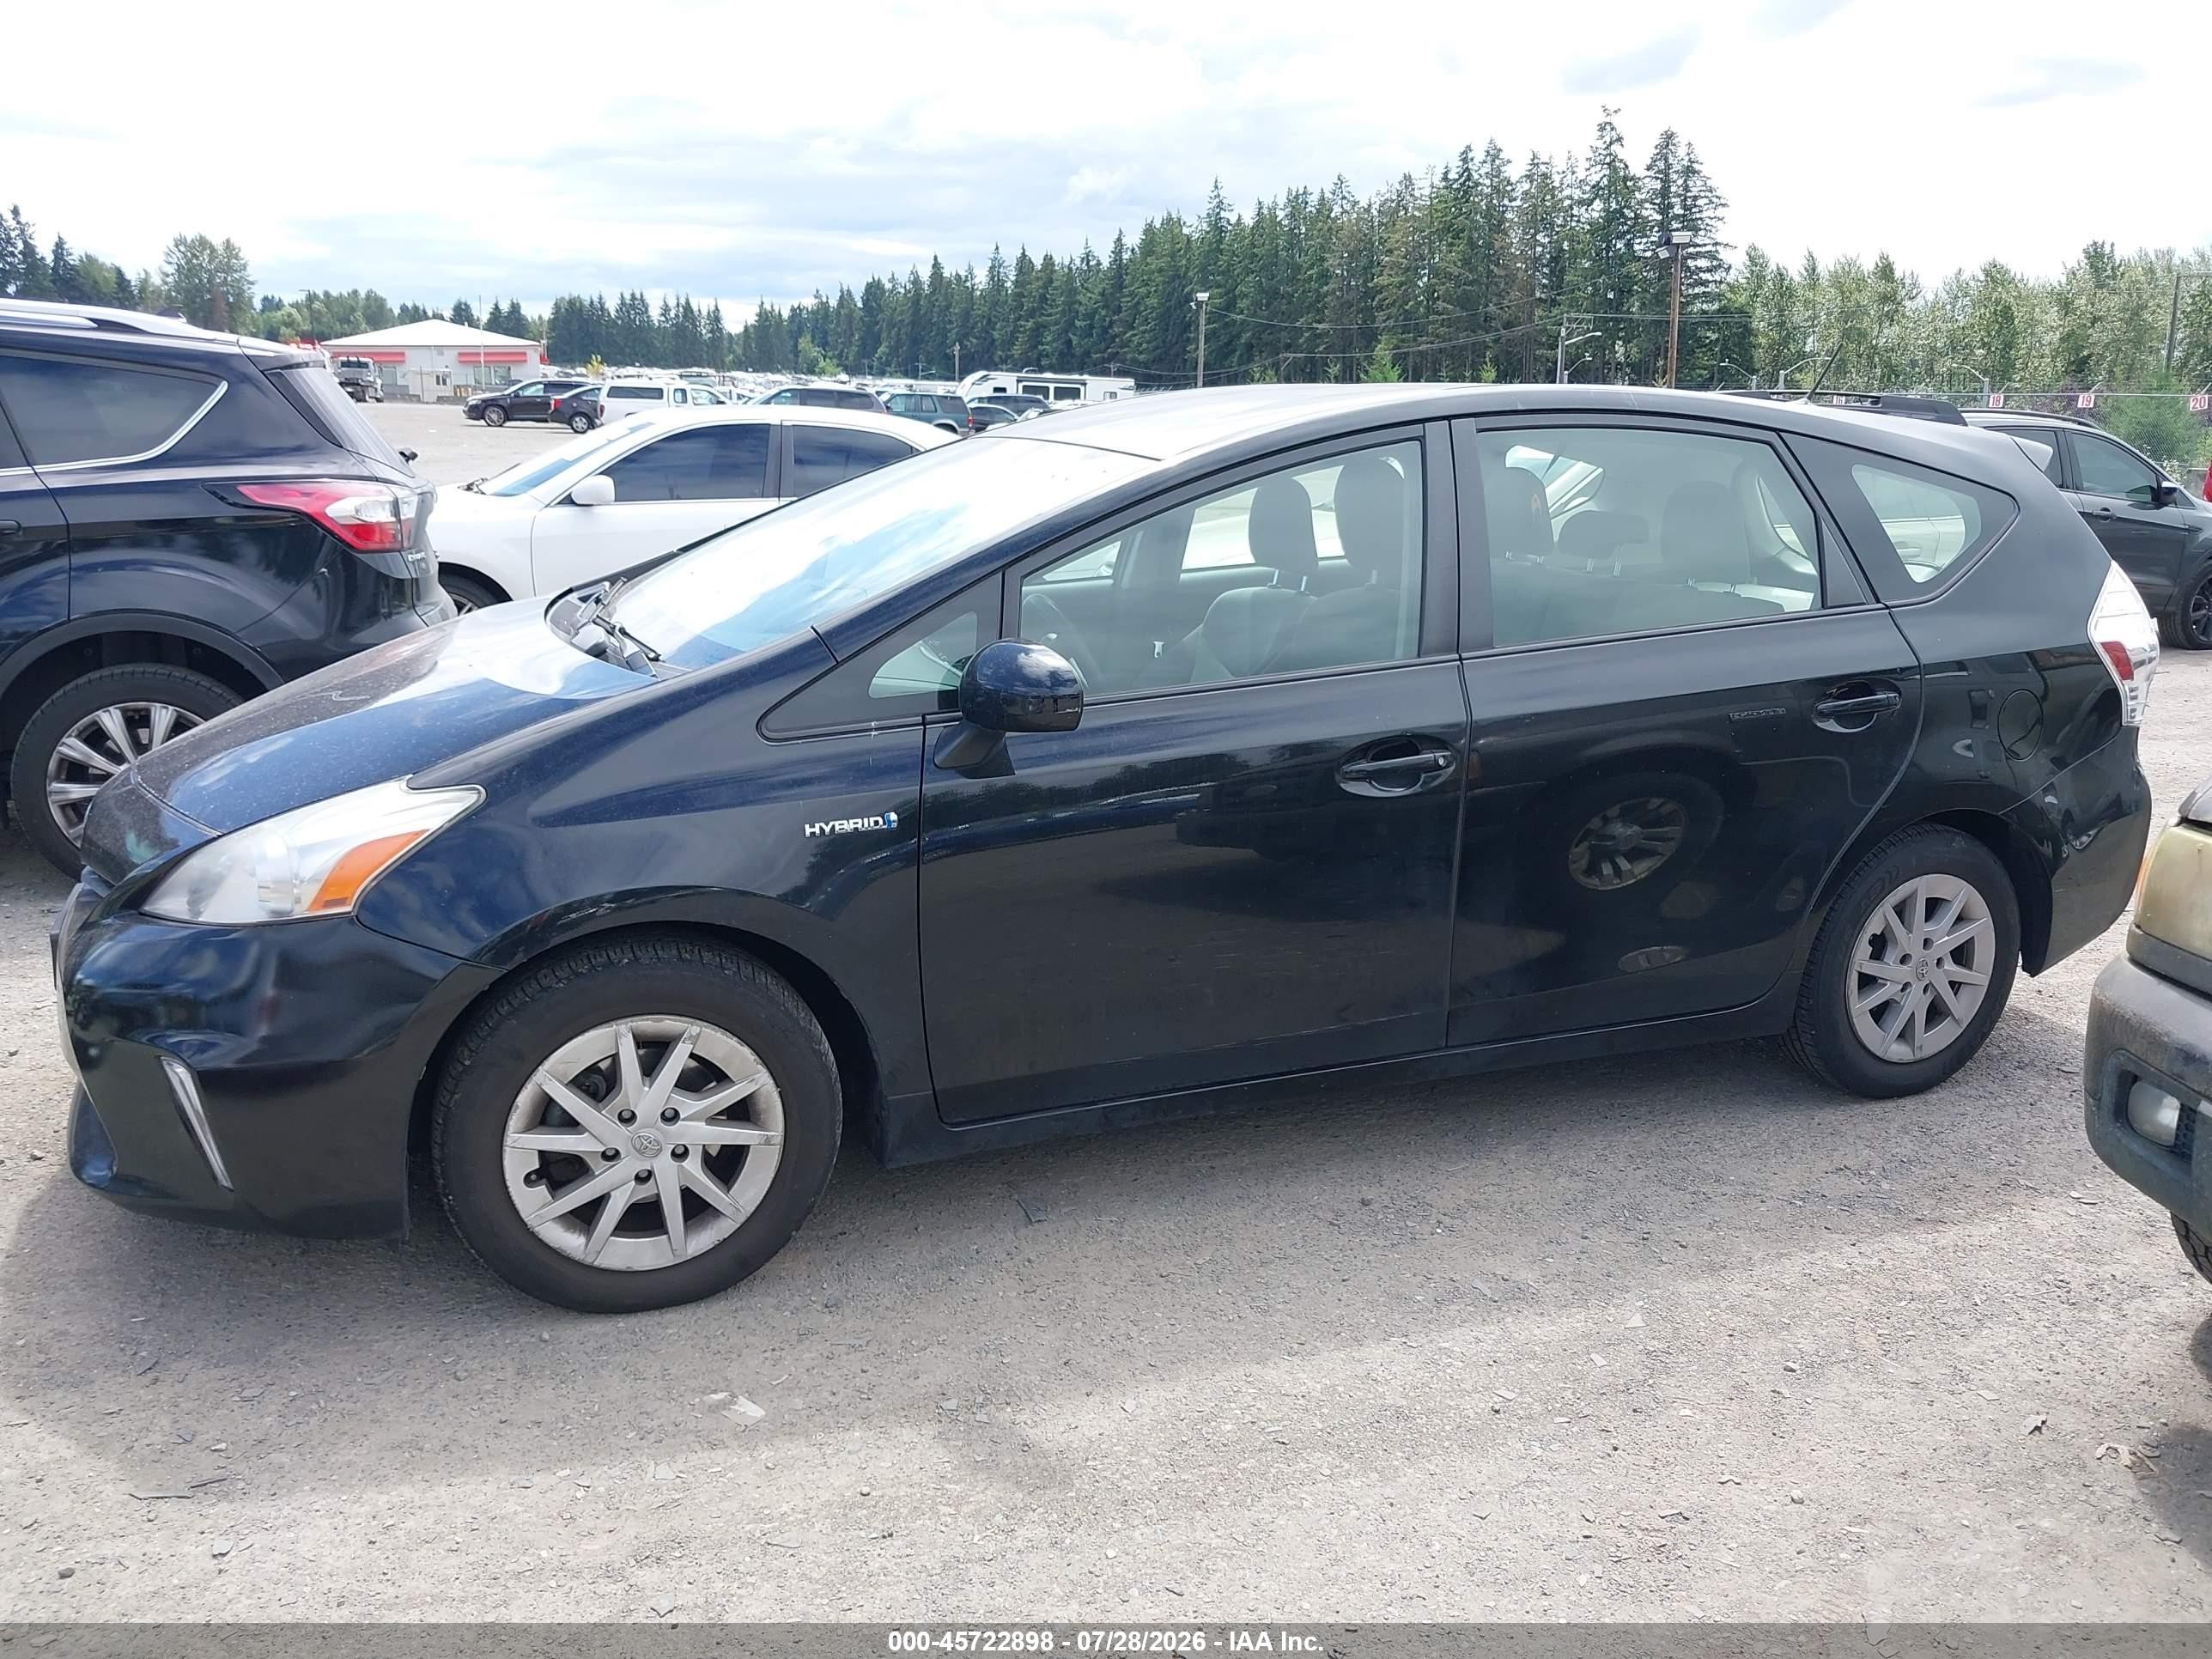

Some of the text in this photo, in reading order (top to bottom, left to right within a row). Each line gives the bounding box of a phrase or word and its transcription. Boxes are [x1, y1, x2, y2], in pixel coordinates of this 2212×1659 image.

[1991, 395, 2002, 407] 18
[2081, 395, 2092, 407] 19
[2191, 396, 2206, 410] 20
[804, 816, 884, 838] HYBRID
